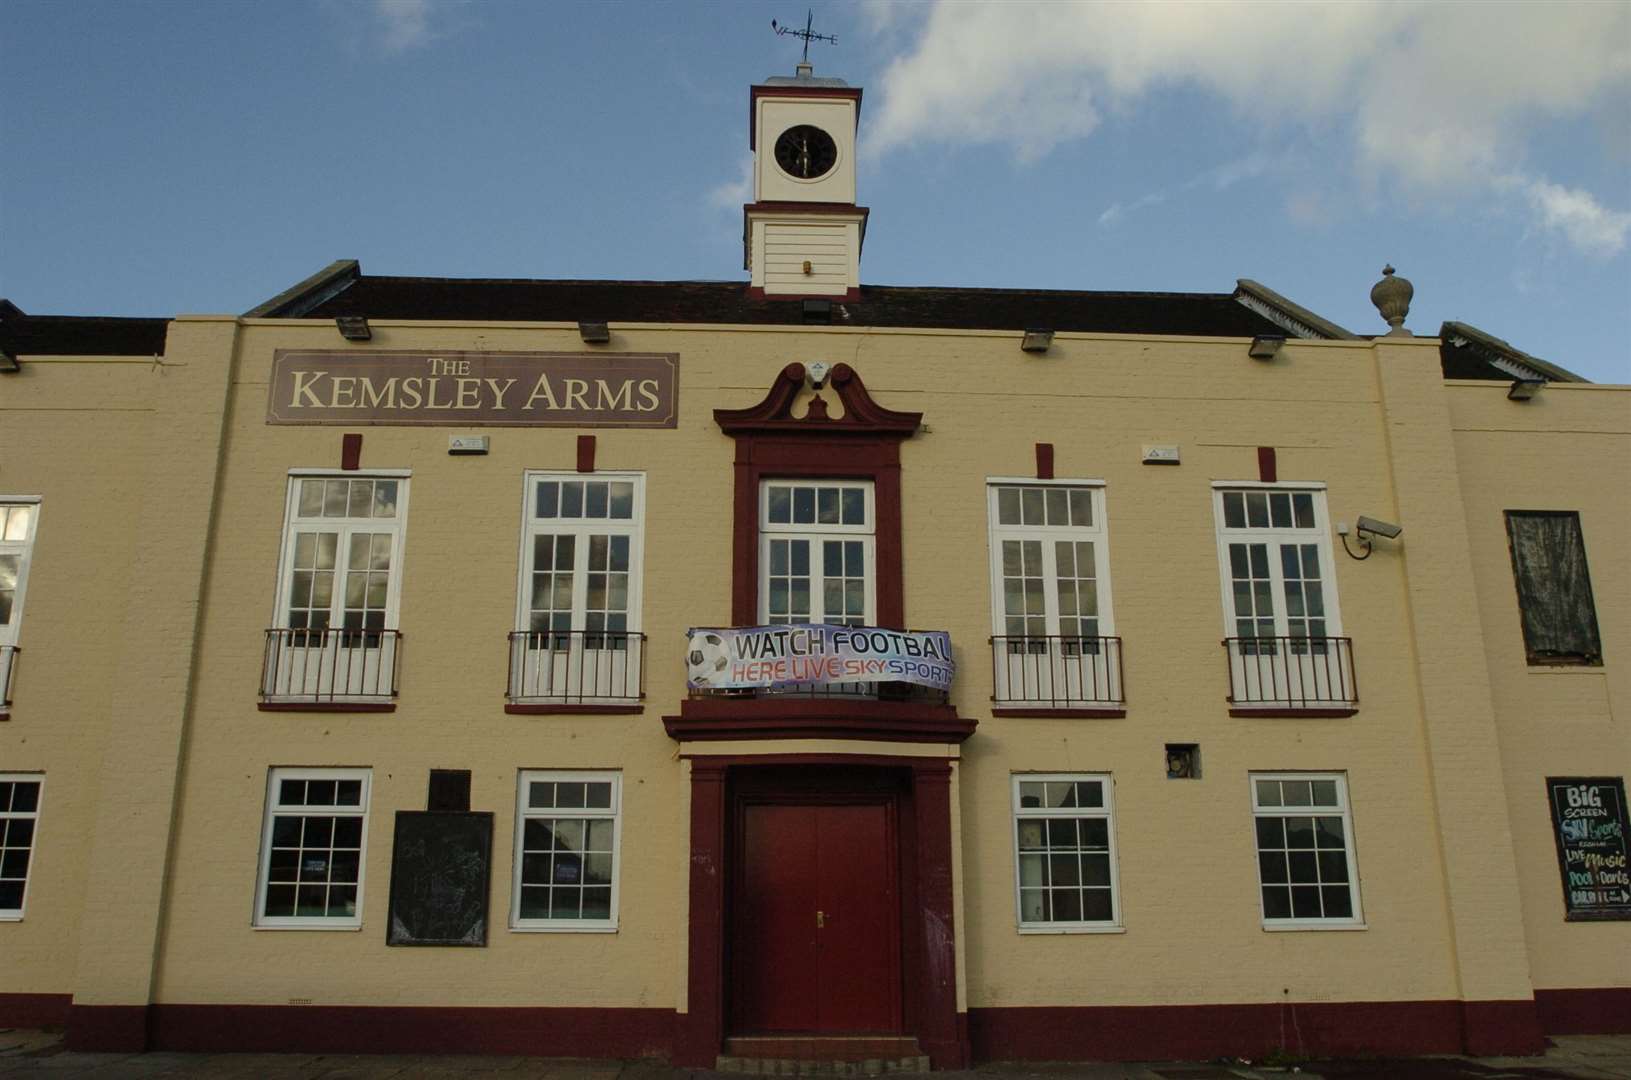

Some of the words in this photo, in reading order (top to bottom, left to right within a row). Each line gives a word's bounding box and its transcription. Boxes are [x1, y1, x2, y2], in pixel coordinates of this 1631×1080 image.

[427, 357, 471, 376] THE
[287, 371, 518, 410] KEMSLEY
[526, 373, 660, 412] ARMS
[735, 627, 825, 660] WATCH
[833, 631, 952, 662] FOOTBAL
[732, 660, 786, 682] HERE
[791, 657, 842, 680] LIVE
[844, 659, 887, 675] SKY
[1564, 807, 1608, 818] SCREEN
